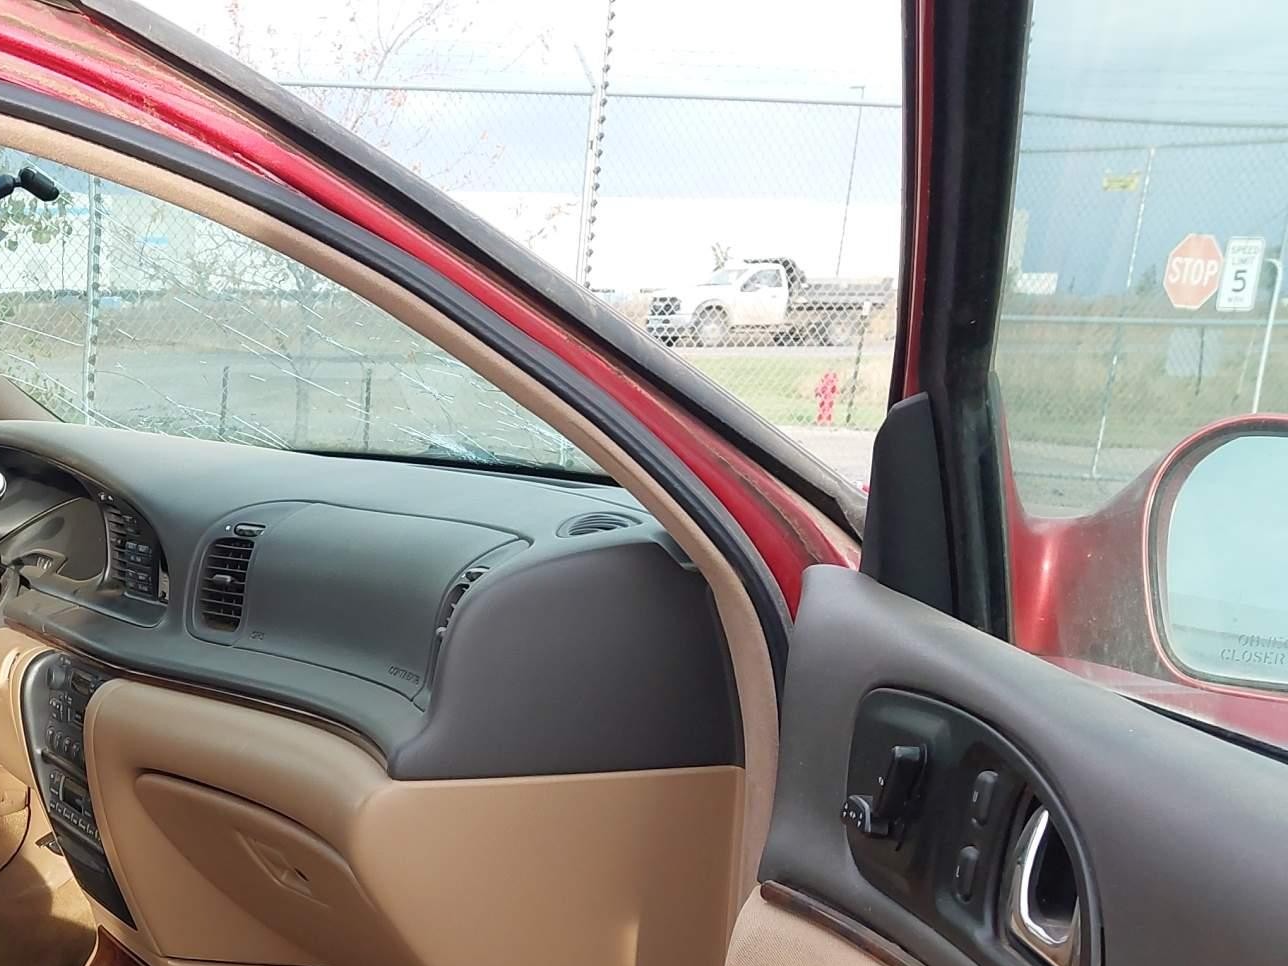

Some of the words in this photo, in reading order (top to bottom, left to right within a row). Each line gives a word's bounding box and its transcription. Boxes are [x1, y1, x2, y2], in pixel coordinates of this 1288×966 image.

[1168, 256, 1218, 287] STOP
[1231, 269, 1248, 293] 5
[1220, 648, 1287, 665] CLOSER
